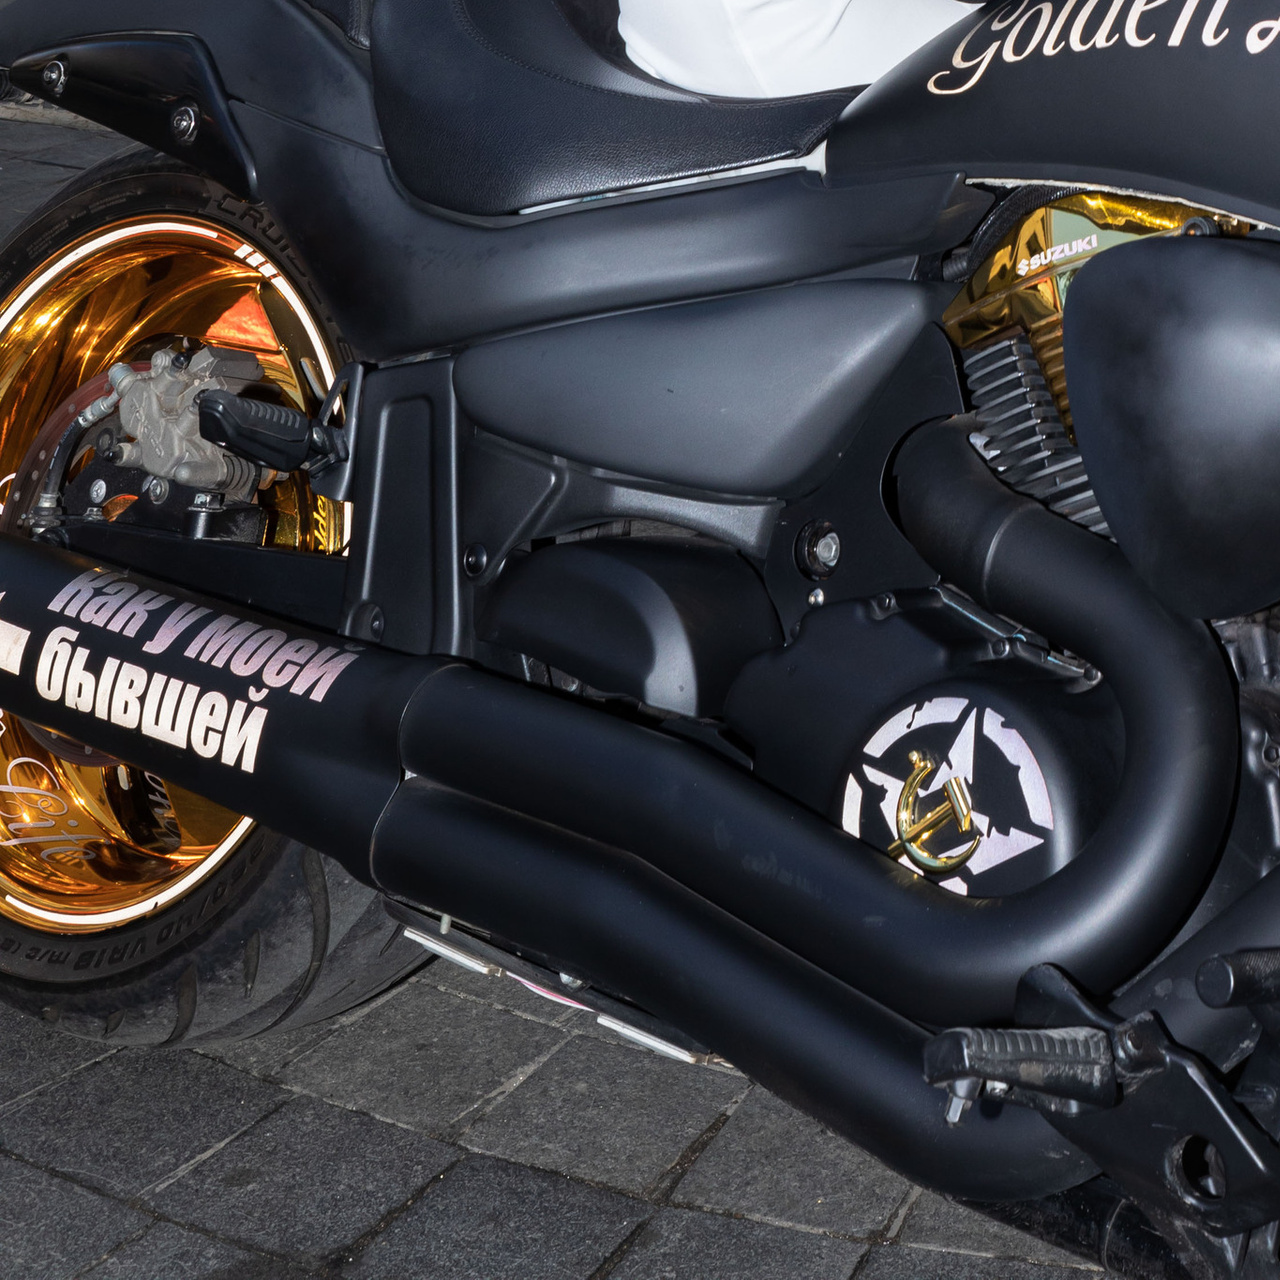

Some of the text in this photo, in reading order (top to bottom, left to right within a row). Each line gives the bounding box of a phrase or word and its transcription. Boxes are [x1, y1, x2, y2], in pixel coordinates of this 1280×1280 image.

[1029, 233, 1098, 271] SUZUKI
[35, 625, 269, 774] бывшей
[142, 604, 204, 655] у
[183, 614, 366, 703] моей
